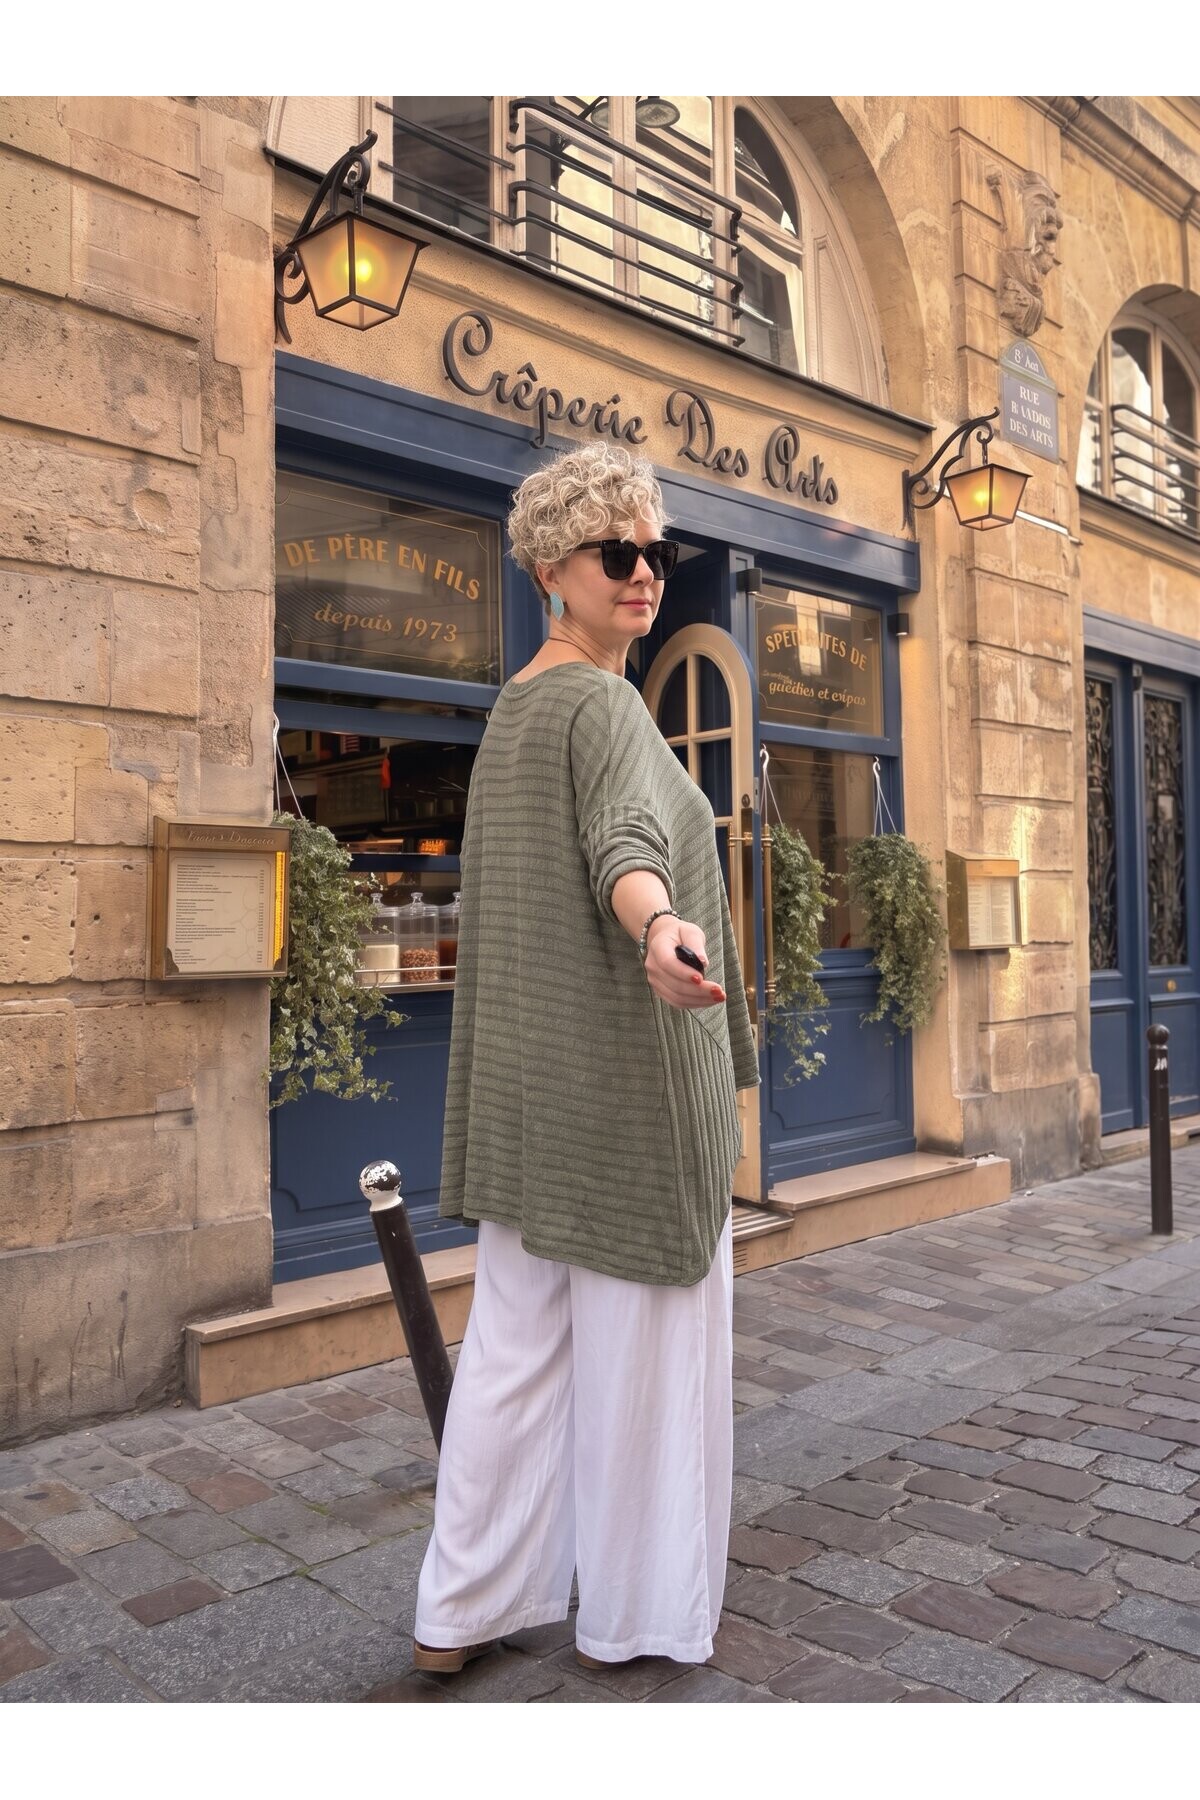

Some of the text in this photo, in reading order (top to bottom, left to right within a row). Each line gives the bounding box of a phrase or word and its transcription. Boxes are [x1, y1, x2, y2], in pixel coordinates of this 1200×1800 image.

[442, 310, 839, 505] Crêperie Des Arts
[1019, 385, 1040, 406] RUE
[1009, 417, 1054, 449] DES ARTS
[283, 533, 480, 601] DE PÈRE EN FILS
[403, 616, 458, 643] 1973
[850, 646, 867, 671] DE
[817, 688, 830, 701] et
